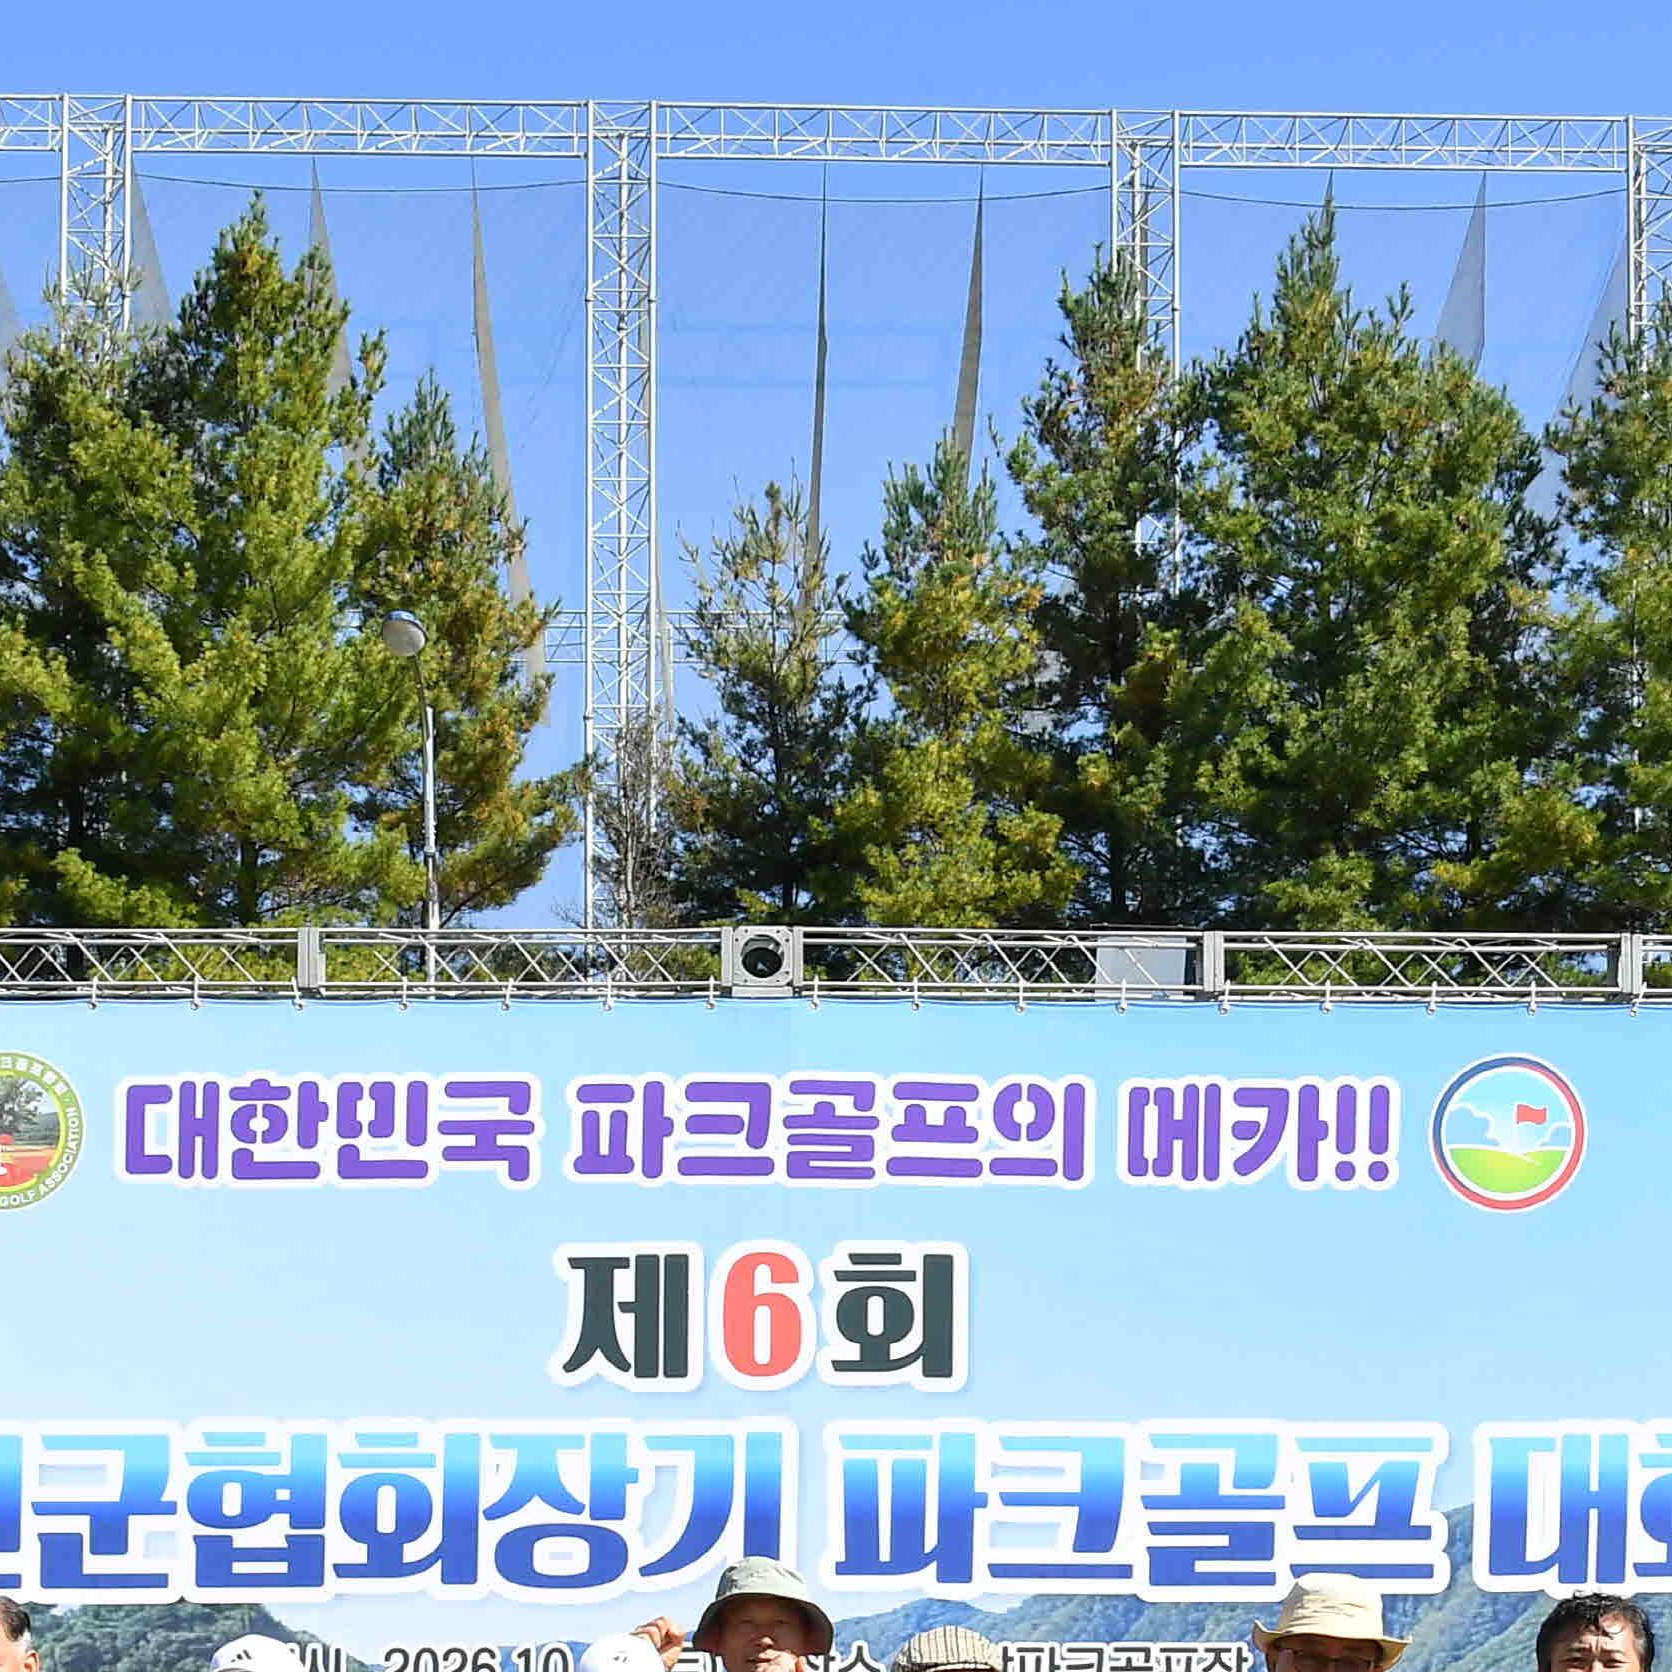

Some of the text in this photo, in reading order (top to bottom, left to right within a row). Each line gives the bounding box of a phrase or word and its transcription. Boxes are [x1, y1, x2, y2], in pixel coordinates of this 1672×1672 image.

[38, 1106, 81, 1196] ASSOCIATION
[125, 1078, 1391, 1183] 대한민국 파크골프의 메카!!
[563, 1250, 956, 1379] 제6회
[833, 1430, 1434, 1586] 파크골프
